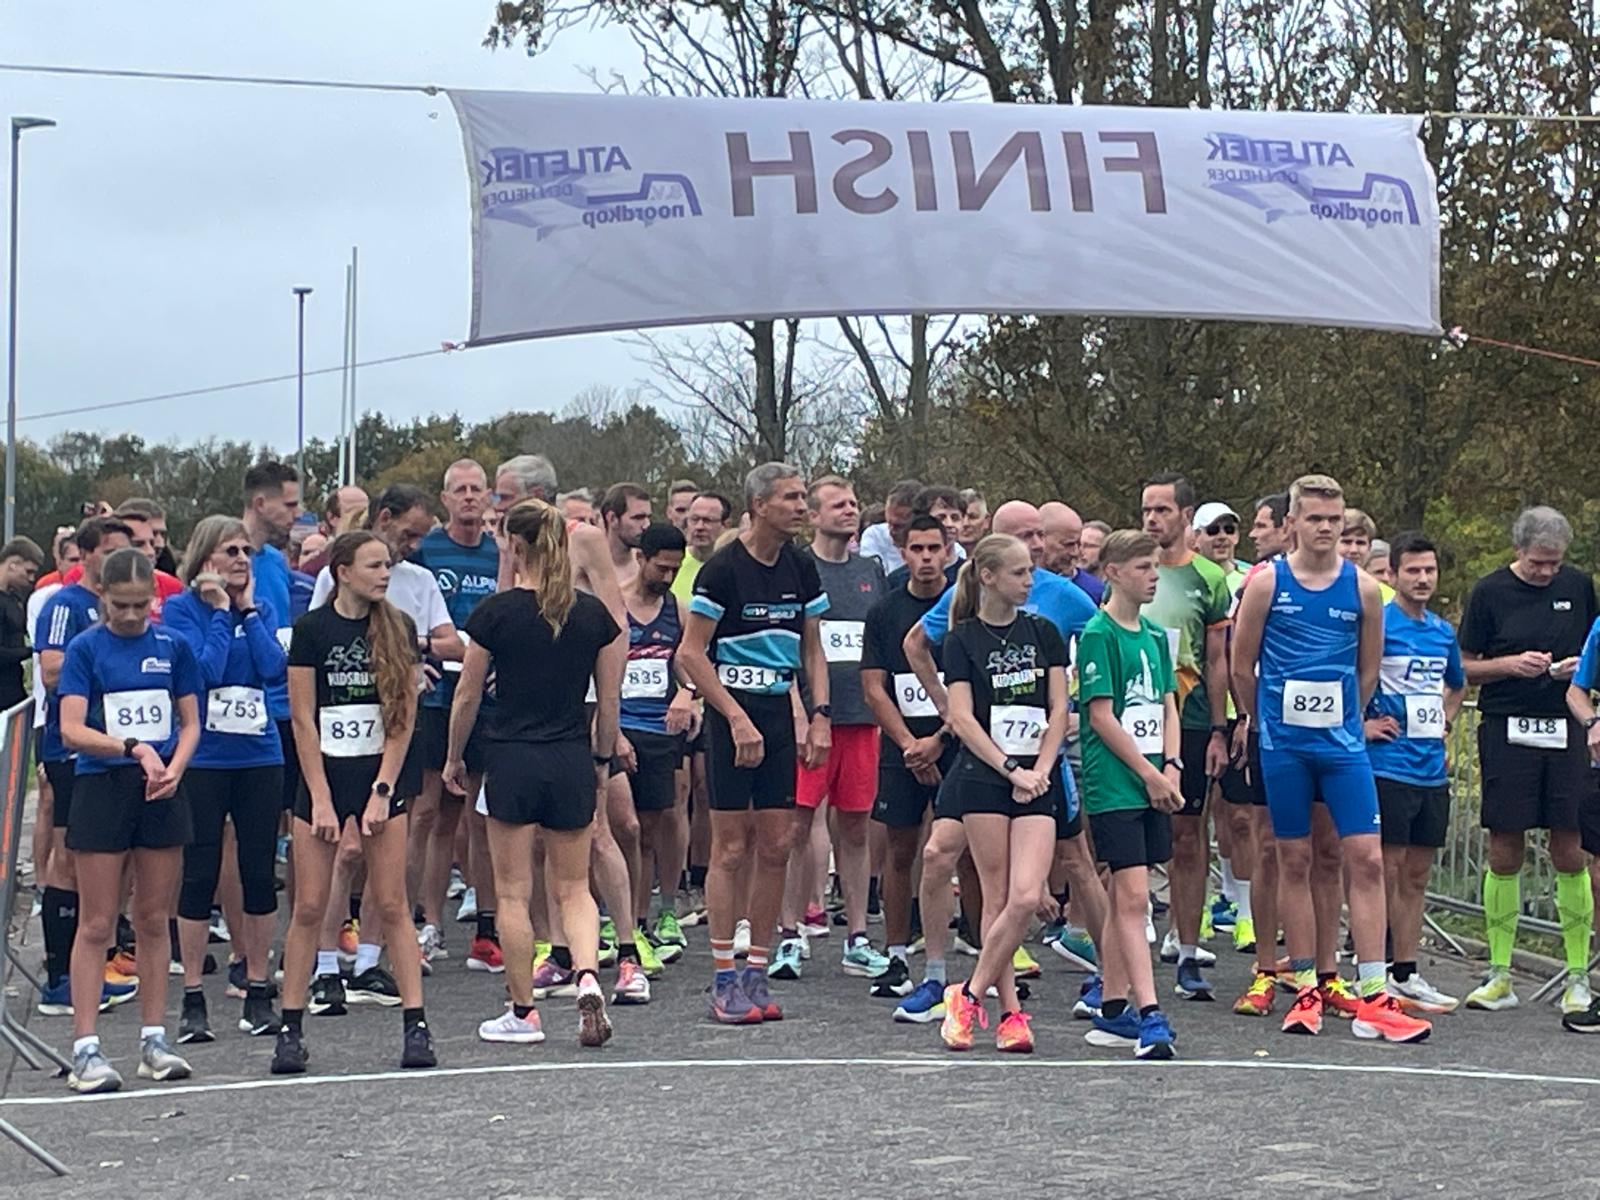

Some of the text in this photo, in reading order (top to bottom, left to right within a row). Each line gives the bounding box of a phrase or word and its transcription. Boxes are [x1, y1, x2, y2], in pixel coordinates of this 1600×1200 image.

[830, 633, 864, 648] 813
[629, 670, 662, 685] 835
[726, 667, 764, 685] 931
[904, 687, 929, 703] 90
[1293, 695, 1335, 713] 822
[117, 705, 163, 726] 819
[221, 699, 258, 719] 753
[331, 720, 376, 740] 837
[1003, 720, 1041, 738] 772
[1133, 719, 1163, 738] 82
[1518, 718, 1557, 734] 918
